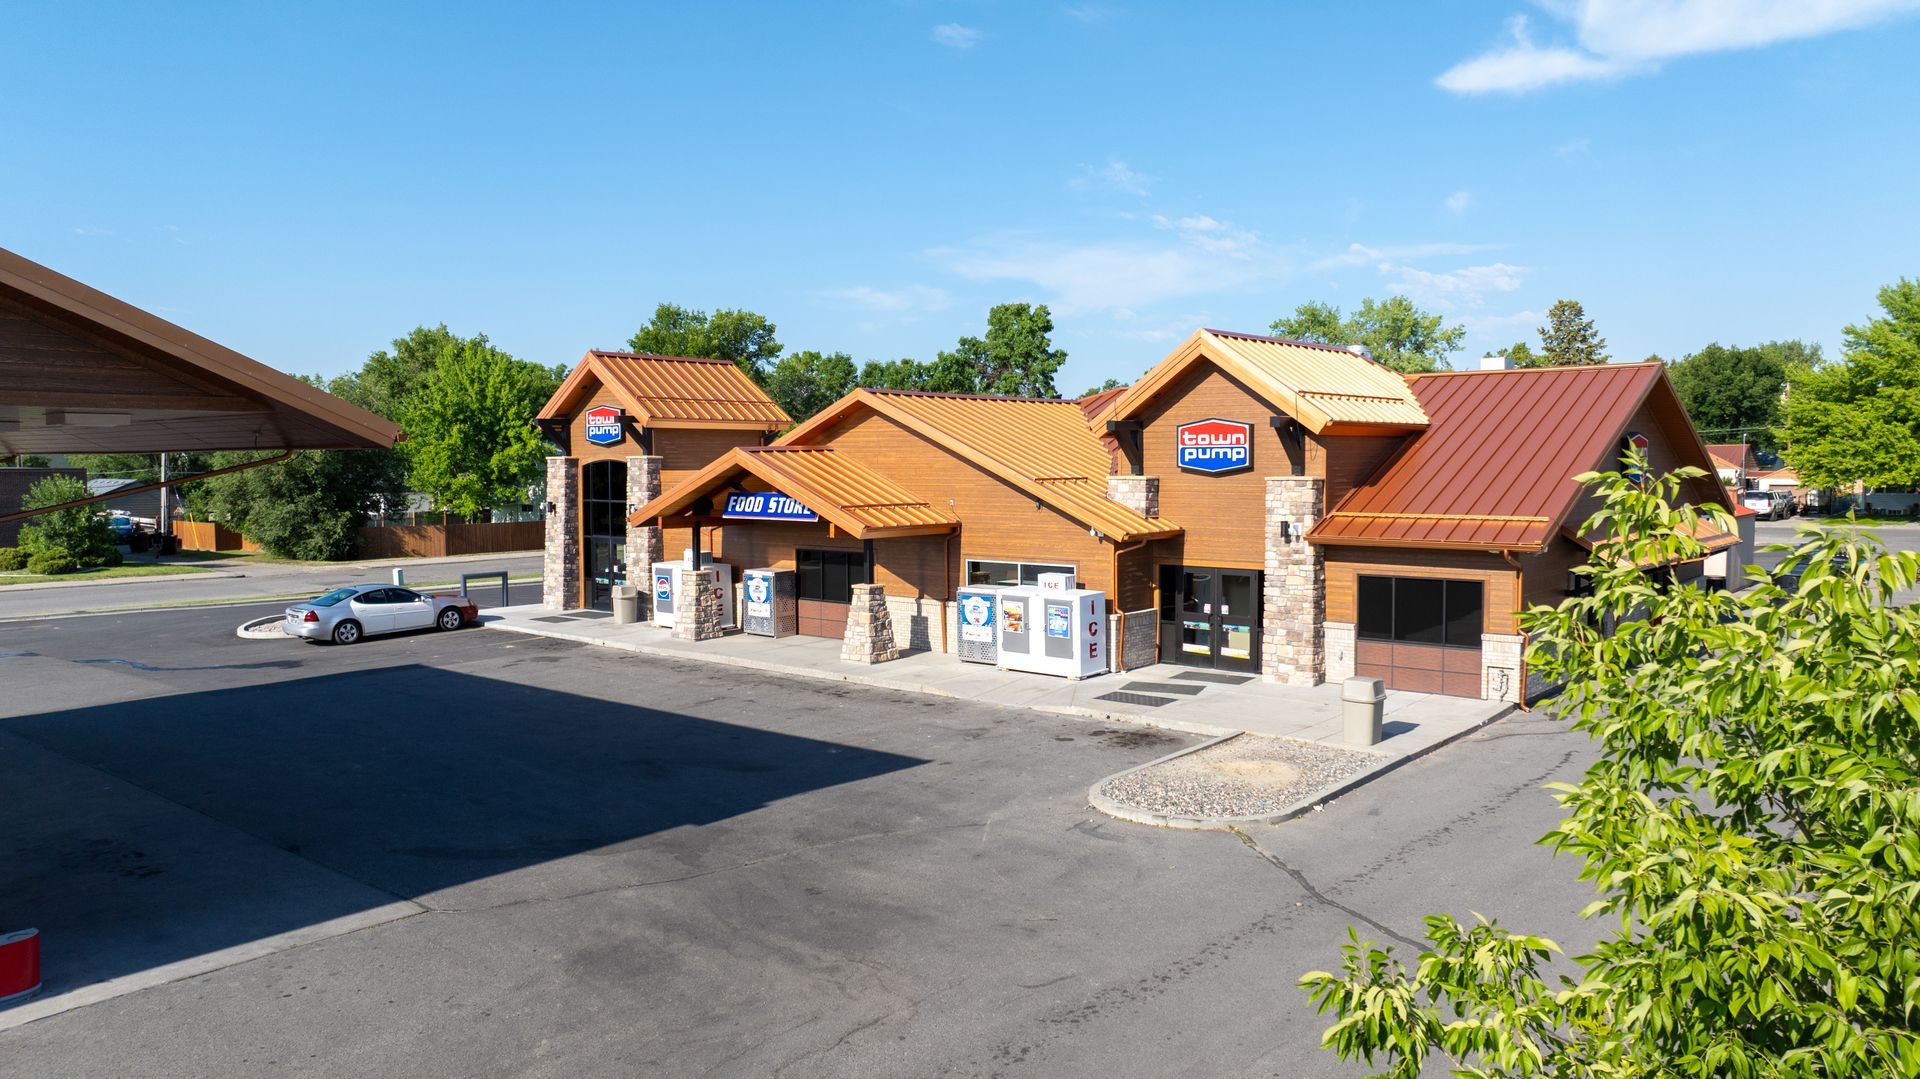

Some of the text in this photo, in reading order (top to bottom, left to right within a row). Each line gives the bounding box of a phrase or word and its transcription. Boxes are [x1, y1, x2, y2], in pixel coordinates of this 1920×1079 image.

[589, 426, 619, 437] pump
[1182, 431, 1245, 445] town
[1184, 448, 1245, 462] pump
[727, 496, 764, 513] FOOD
[1088, 600, 1098, 659] ICE
